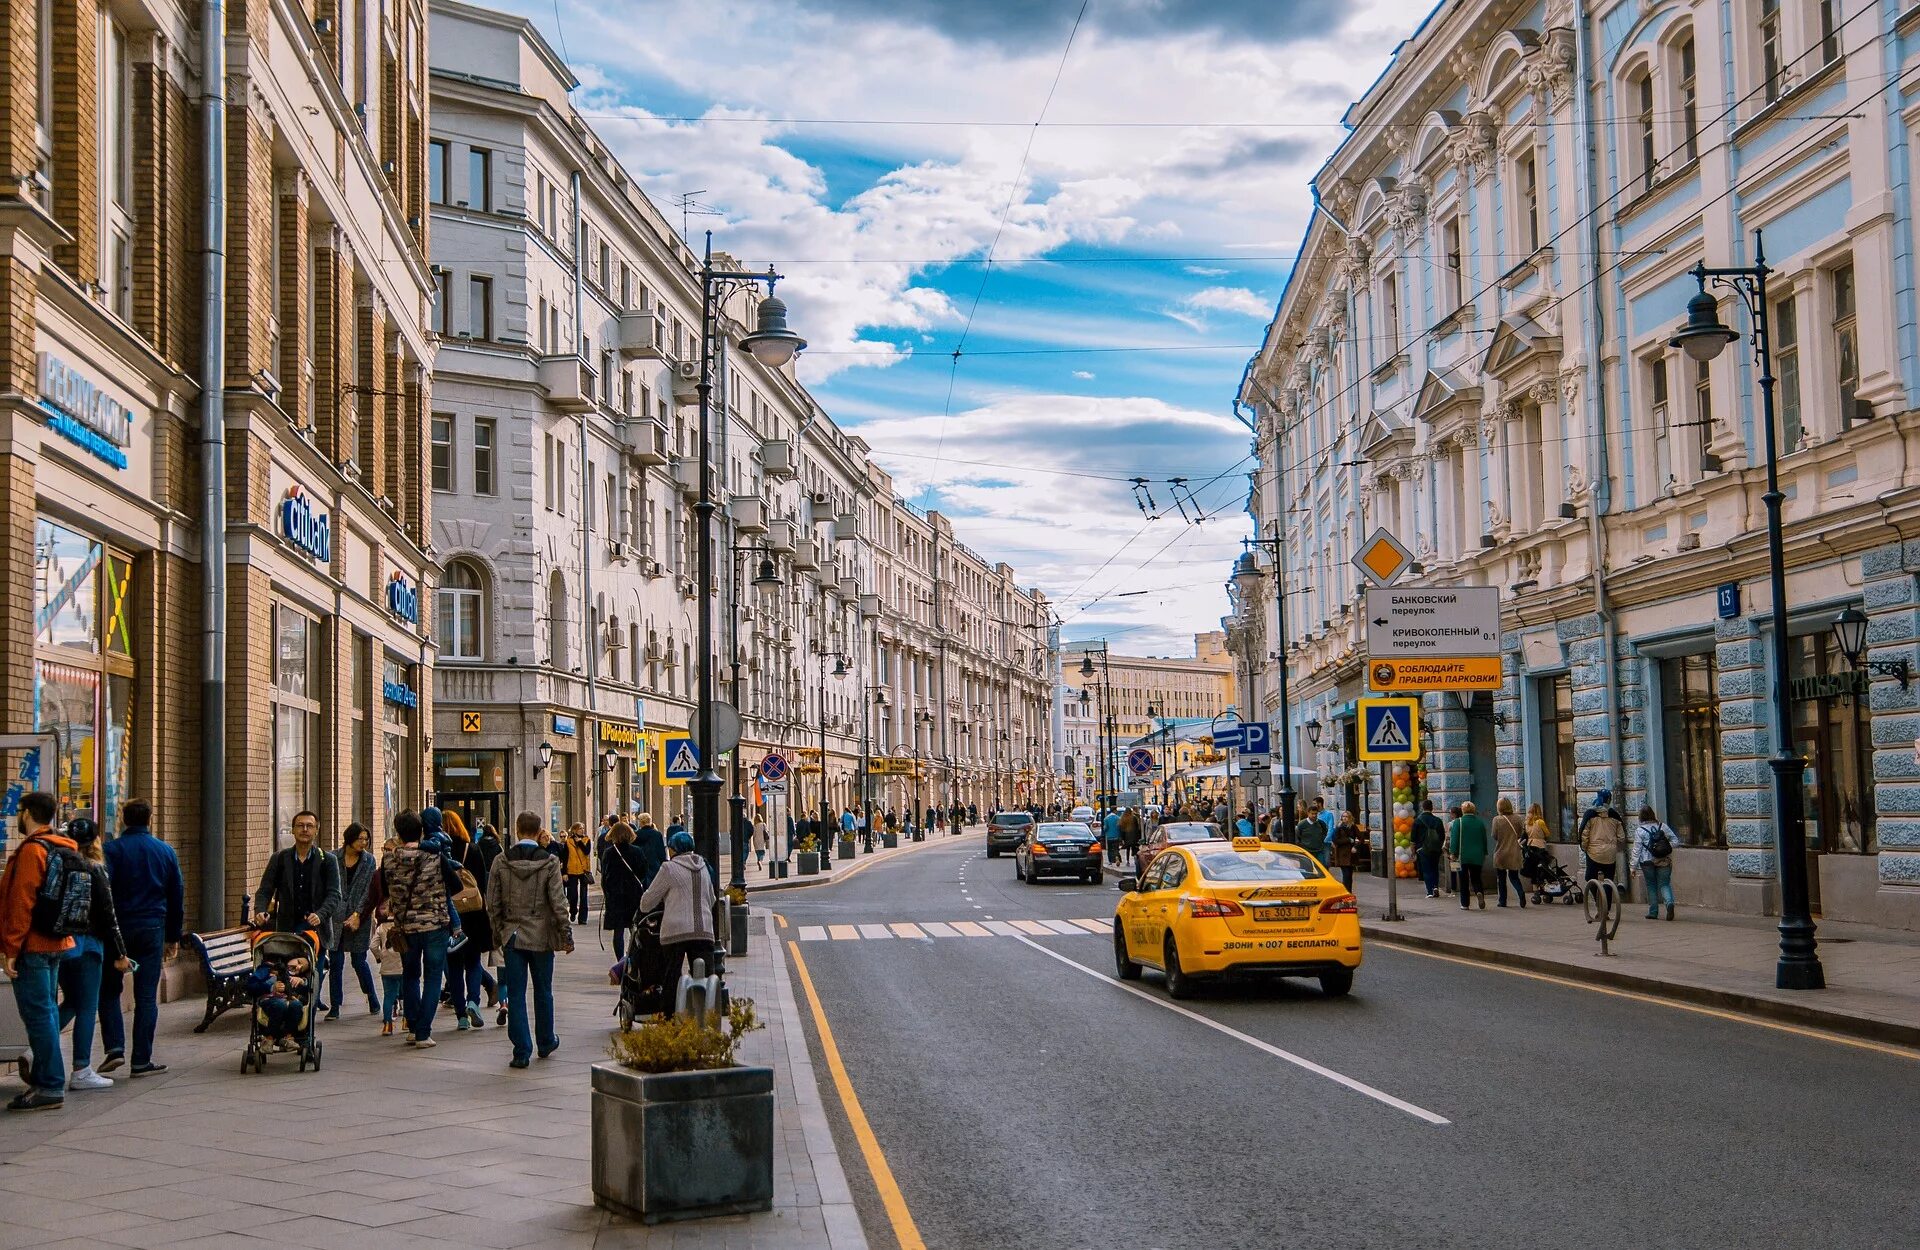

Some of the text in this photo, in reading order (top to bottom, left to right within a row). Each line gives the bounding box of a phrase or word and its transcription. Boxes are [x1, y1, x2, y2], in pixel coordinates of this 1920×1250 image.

[290, 496, 330, 563] citibank
[1391, 594, 1457, 604] БАНКОВСКИЙ
[1720, 589, 1731, 607] 13
[1391, 607, 1435, 616] переулок
[1392, 627, 1480, 637] КРИВОКОЛЕННЫЙ
[1483, 632, 1496, 640] 0.1
[1392, 639, 1437, 649] переулок
[1398, 664, 1465, 673] СОБЛЮДАЙТЕ
[1398, 675, 1498, 684] ПРАВИЛА ПАРКОВКИ!
[1246, 725, 1264, 751] P
[1274, 907, 1292, 917] 303
[1287, 940, 1339, 948] БЕСПЛАТНО!
